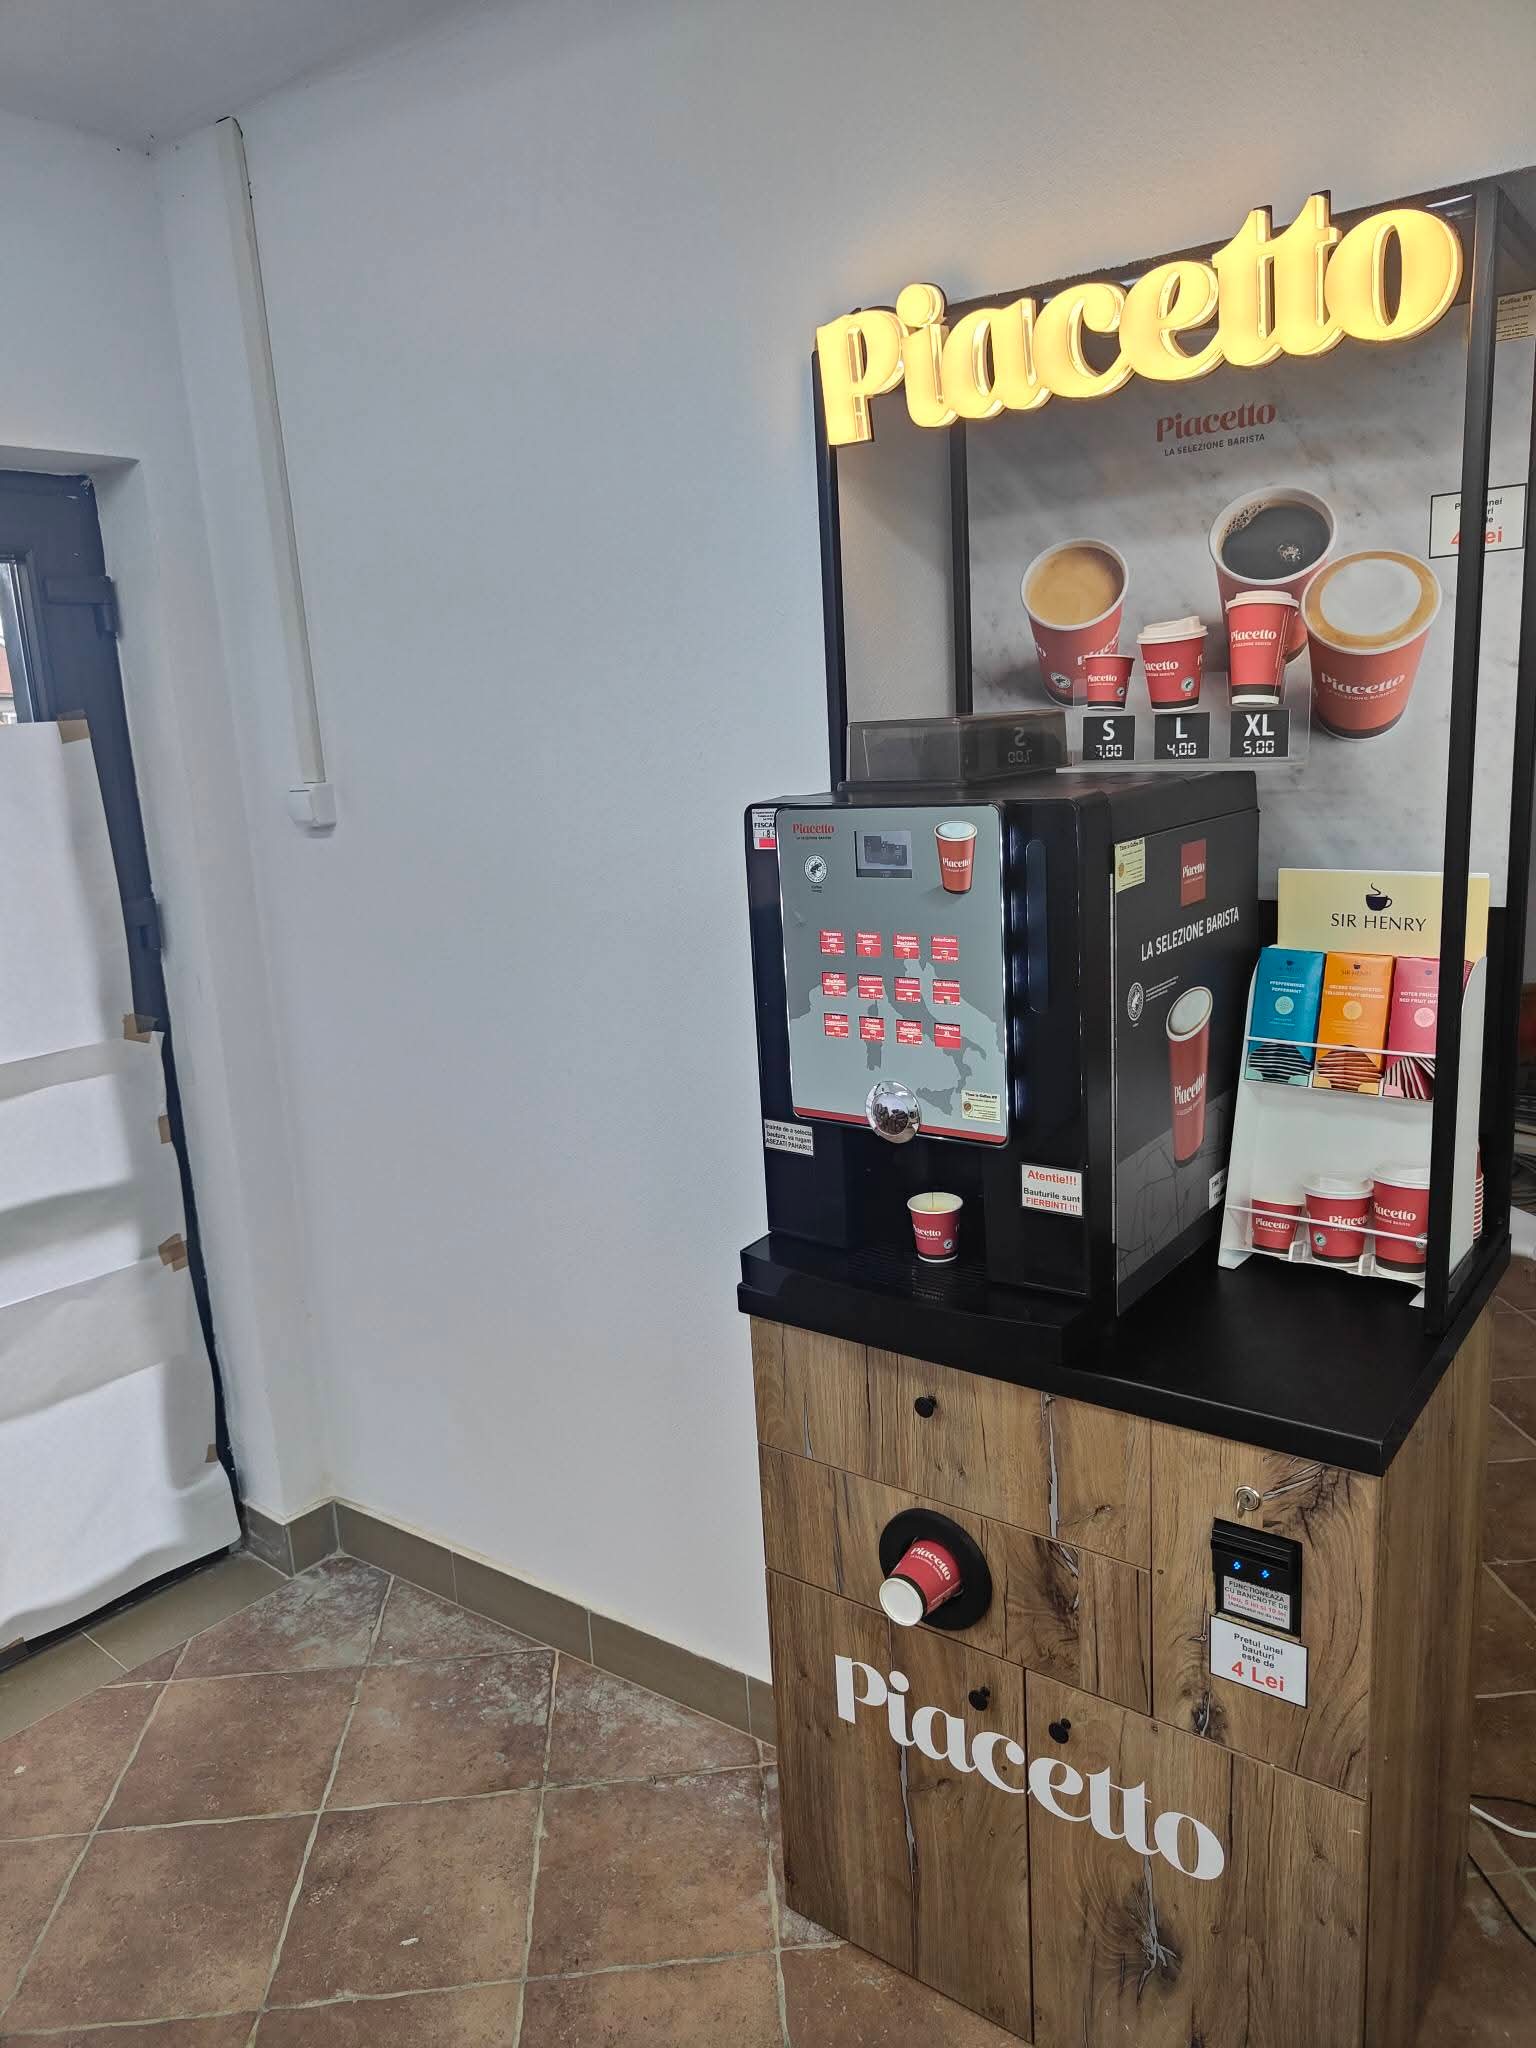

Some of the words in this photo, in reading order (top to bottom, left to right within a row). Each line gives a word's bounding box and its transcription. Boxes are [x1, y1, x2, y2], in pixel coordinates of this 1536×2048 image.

[816, 190, 1464, 446] Piacetto
[1156, 401, 1277, 442] Piacetto
[1164, 447, 1175, 457] LA
[1177, 439, 1225, 454] SELEZIONE
[1228, 433, 1265, 447] BARISTA
[1231, 628, 1277, 643] Piacetto
[1321, 671, 1406, 695] Piacetto
[1102, 719, 1115, 741] S
[1175, 717, 1188, 739] L
[1244, 713, 1275, 737] XL
[792, 823, 835, 834] Piacetto
[942, 857, 971, 869] Piacetto
[1182, 862, 1205, 878] Piacetto
[1330, 912, 1357, 928] SIR
[1364, 915, 1428, 932] HENRY
[1141, 940, 1154, 962] LA
[1155, 919, 1204, 956] SELEZIONE
[1206, 906, 1240, 936] BARISTA
[1174, 1072, 1205, 1105] Piacetto
[1023, 1187, 1060, 1200] Bauturile
[1061, 1194, 1080, 1203] sunt
[1025, 1197, 1067, 1211] FIERBINTI
[1255, 1217, 1290, 1230] Piacetto
[910, 1546, 952, 1581] Piacetto
[1224, 1586, 1235, 1594] CU
[1236, 1590, 1277, 1607] BANCNOTE
[1278, 1602, 1289, 1611] DE
[1228, 1580, 1285, 1603] FUNCTIONEAZA
[1233, 1632, 1261, 1649] Pretul
[1263, 1643, 1284, 1656] unei
[1242, 1644, 1275, 1662] bauturi
[1241, 1652, 1261, 1665] este
[1263, 1657, 1275, 1669] de
[1231, 1660, 1244, 1678] 4
[1251, 1666, 1285, 1693] Lei
[833, 1654, 1225, 1881] Piacetto
